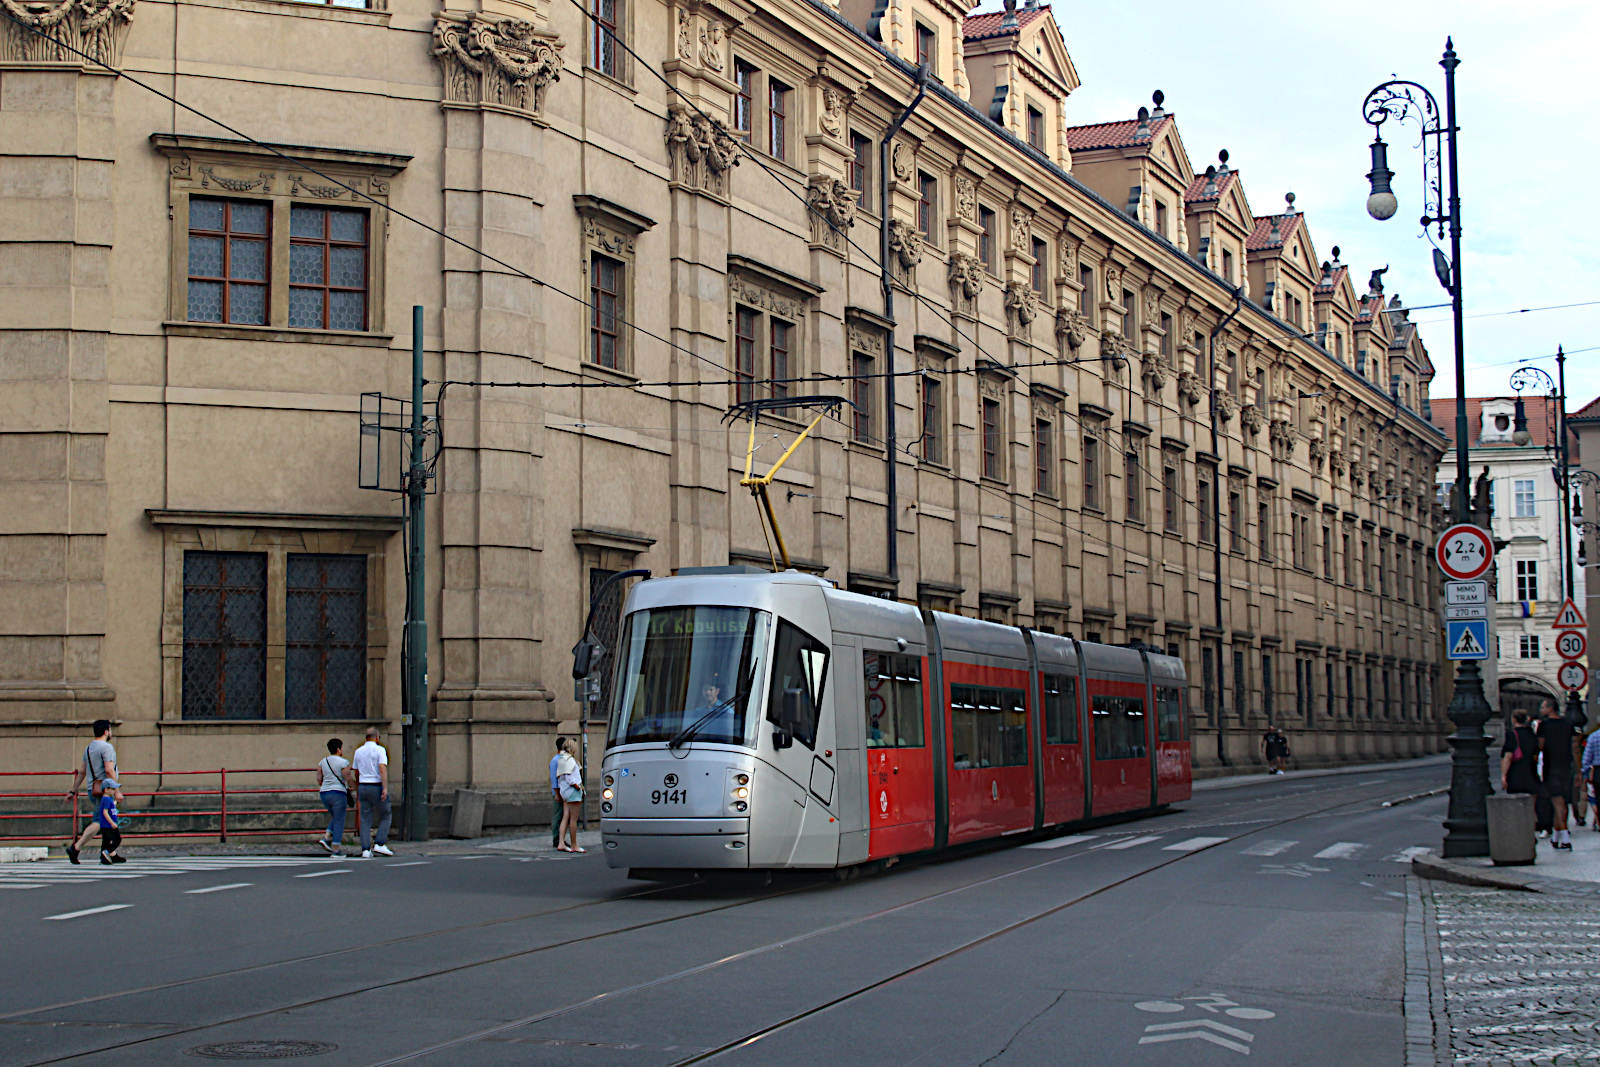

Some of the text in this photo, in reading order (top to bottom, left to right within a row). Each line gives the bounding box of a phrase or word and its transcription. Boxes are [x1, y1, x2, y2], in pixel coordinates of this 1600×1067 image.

[1454, 540, 1475, 554] 2.2
[1456, 585, 1476, 593] MIMO
[1455, 594, 1478, 602] TRAM
[1455, 608, 1469, 617] 270
[650, 614, 748, 634] 17 Kobylisy
[1562, 638, 1581, 653] 30
[651, 789, 687, 805] 9141
